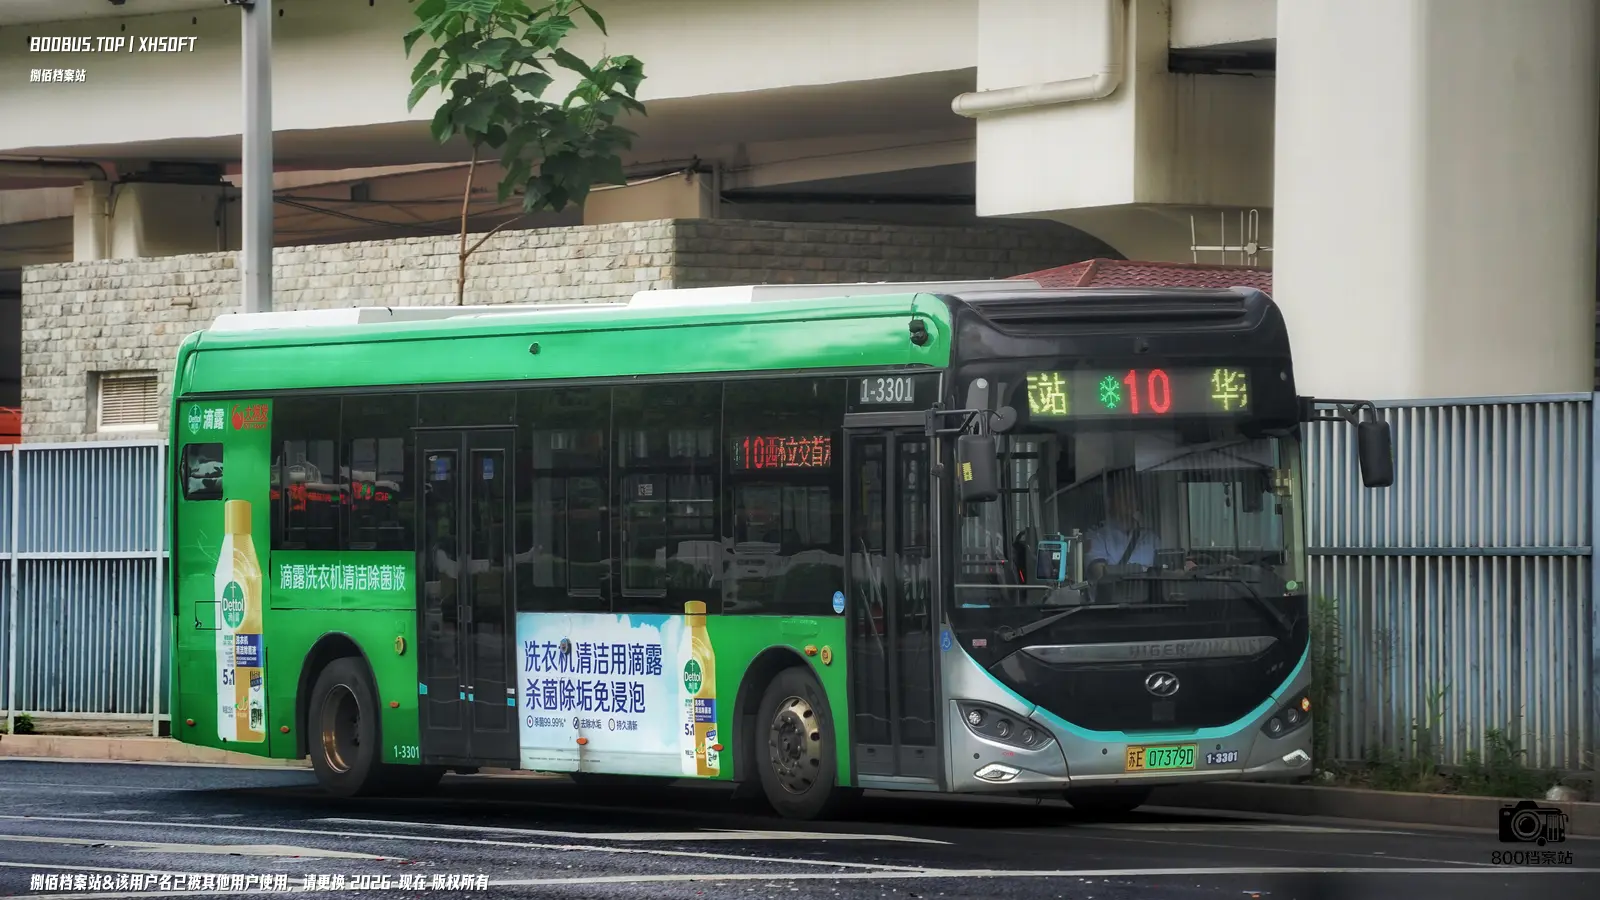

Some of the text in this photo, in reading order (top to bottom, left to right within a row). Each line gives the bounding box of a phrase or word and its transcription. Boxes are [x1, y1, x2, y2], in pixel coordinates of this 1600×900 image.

[861, 377, 912, 402] 1-3301
[1123, 369, 1172, 414] 10
[203, 408, 224, 430] 滴露
[280, 564, 406, 591] 滴露洗衣机清洁除菌液
[223, 598, 244, 611] Dettol
[524, 640, 663, 676] 洗衣机清洁用滴露
[684, 672, 701, 682] Dettol
[525, 678, 646, 714] 杀菌除垢免浸泡
[580, 719, 602, 730] 去除水垢
[616, 720, 638, 731] 持久清新
[393, 745, 420, 759] 1-3301
